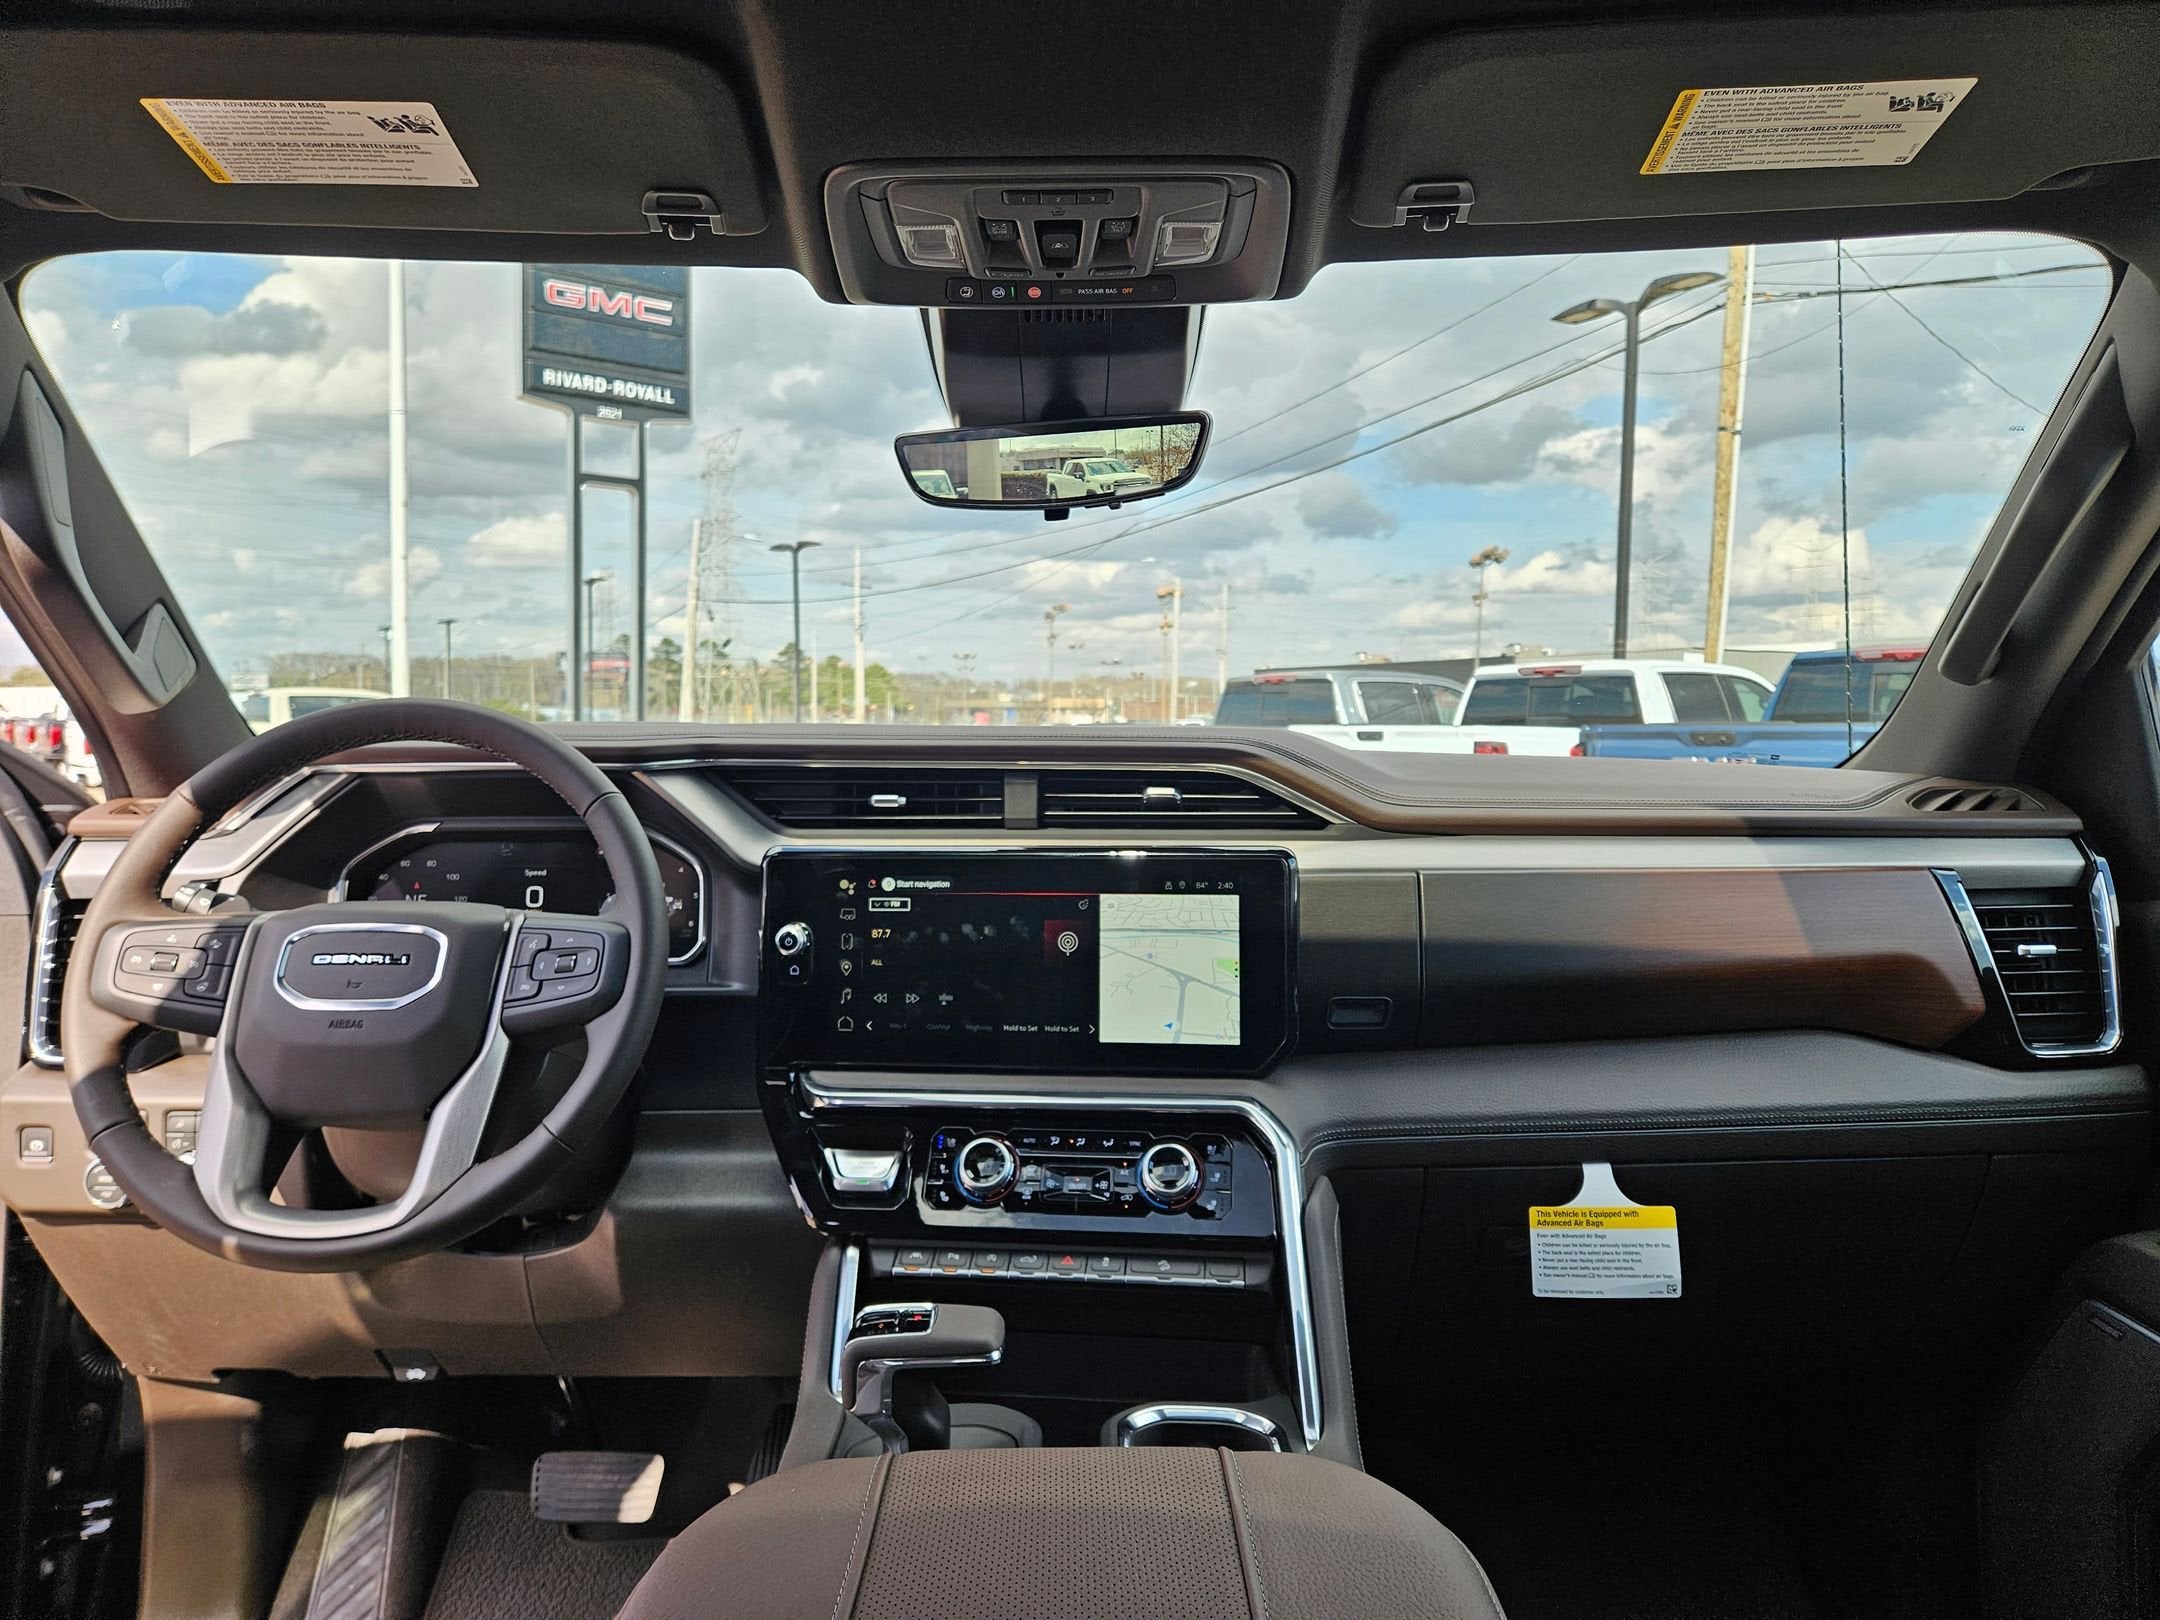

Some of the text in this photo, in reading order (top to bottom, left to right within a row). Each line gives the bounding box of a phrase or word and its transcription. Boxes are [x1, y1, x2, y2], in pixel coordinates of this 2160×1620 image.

[1759, 86, 1814, 94] ADVANCED
[1672, 93, 1696, 123] WARNING
[1781, 125, 1839, 133] GONFLABLES
[1840, 123, 1902, 131] INTELLIGENTS
[543, 279, 673, 327] GMC
[542, 368, 675, 404] RIVARD-ROYALL
[379, 873, 389, 881] 40
[446, 873, 460, 881] 100
[524, 869, 547, 877] Speed
[896, 880, 951, 890] Start navigation
[1196, 881, 1209, 889] 84°
[525, 885, 544, 908] 0
[871, 929, 891, 938] 87.7
[312, 954, 409, 965] DENALI
[328, 1019, 364, 1029] AIRBAG
[1589, 1210, 1622, 1219] Equipped
[1537, 1219, 1604, 1228] Advanced Air Bags
